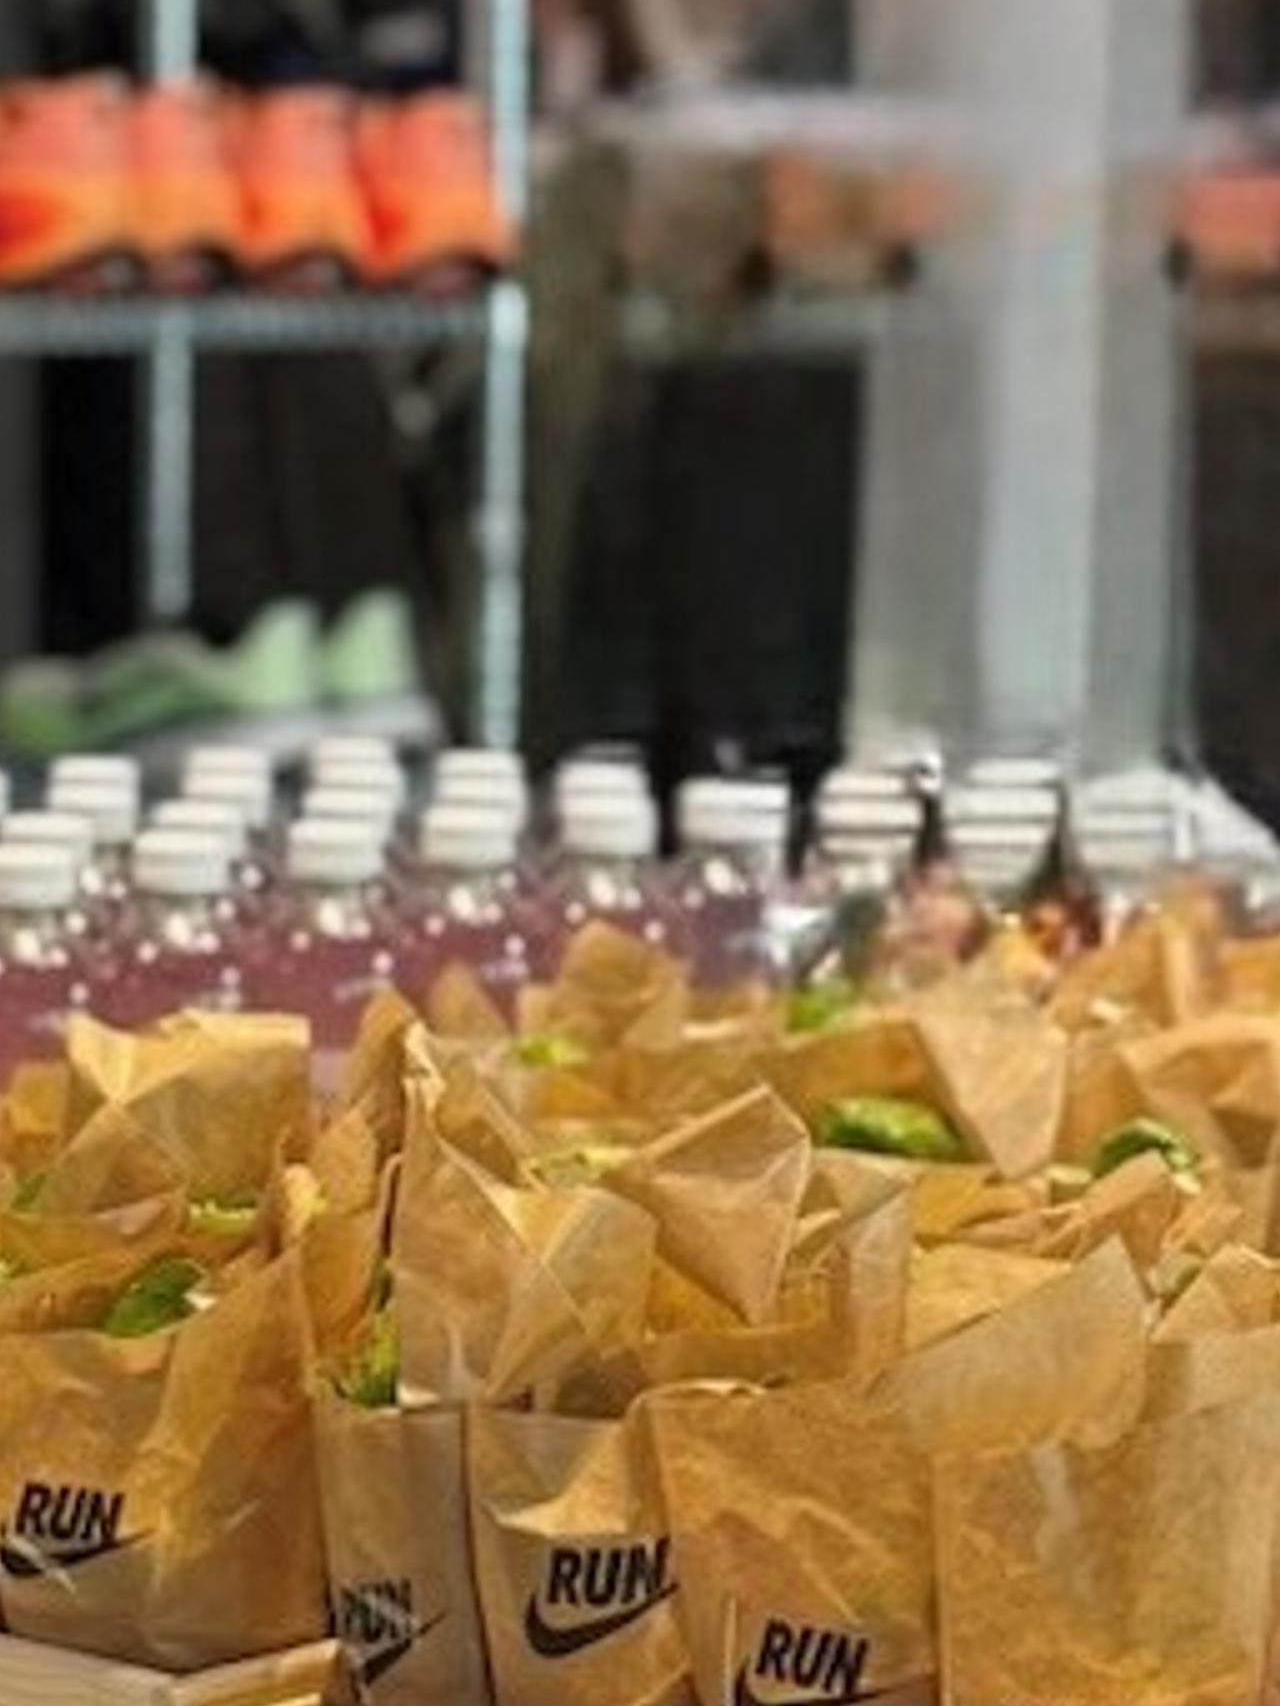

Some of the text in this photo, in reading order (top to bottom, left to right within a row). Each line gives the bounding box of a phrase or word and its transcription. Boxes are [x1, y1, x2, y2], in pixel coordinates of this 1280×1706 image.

[18, 1481, 124, 1542] RUN
[546, 1536, 670, 1606] RUN
[755, 1618, 870, 1695] RUN
